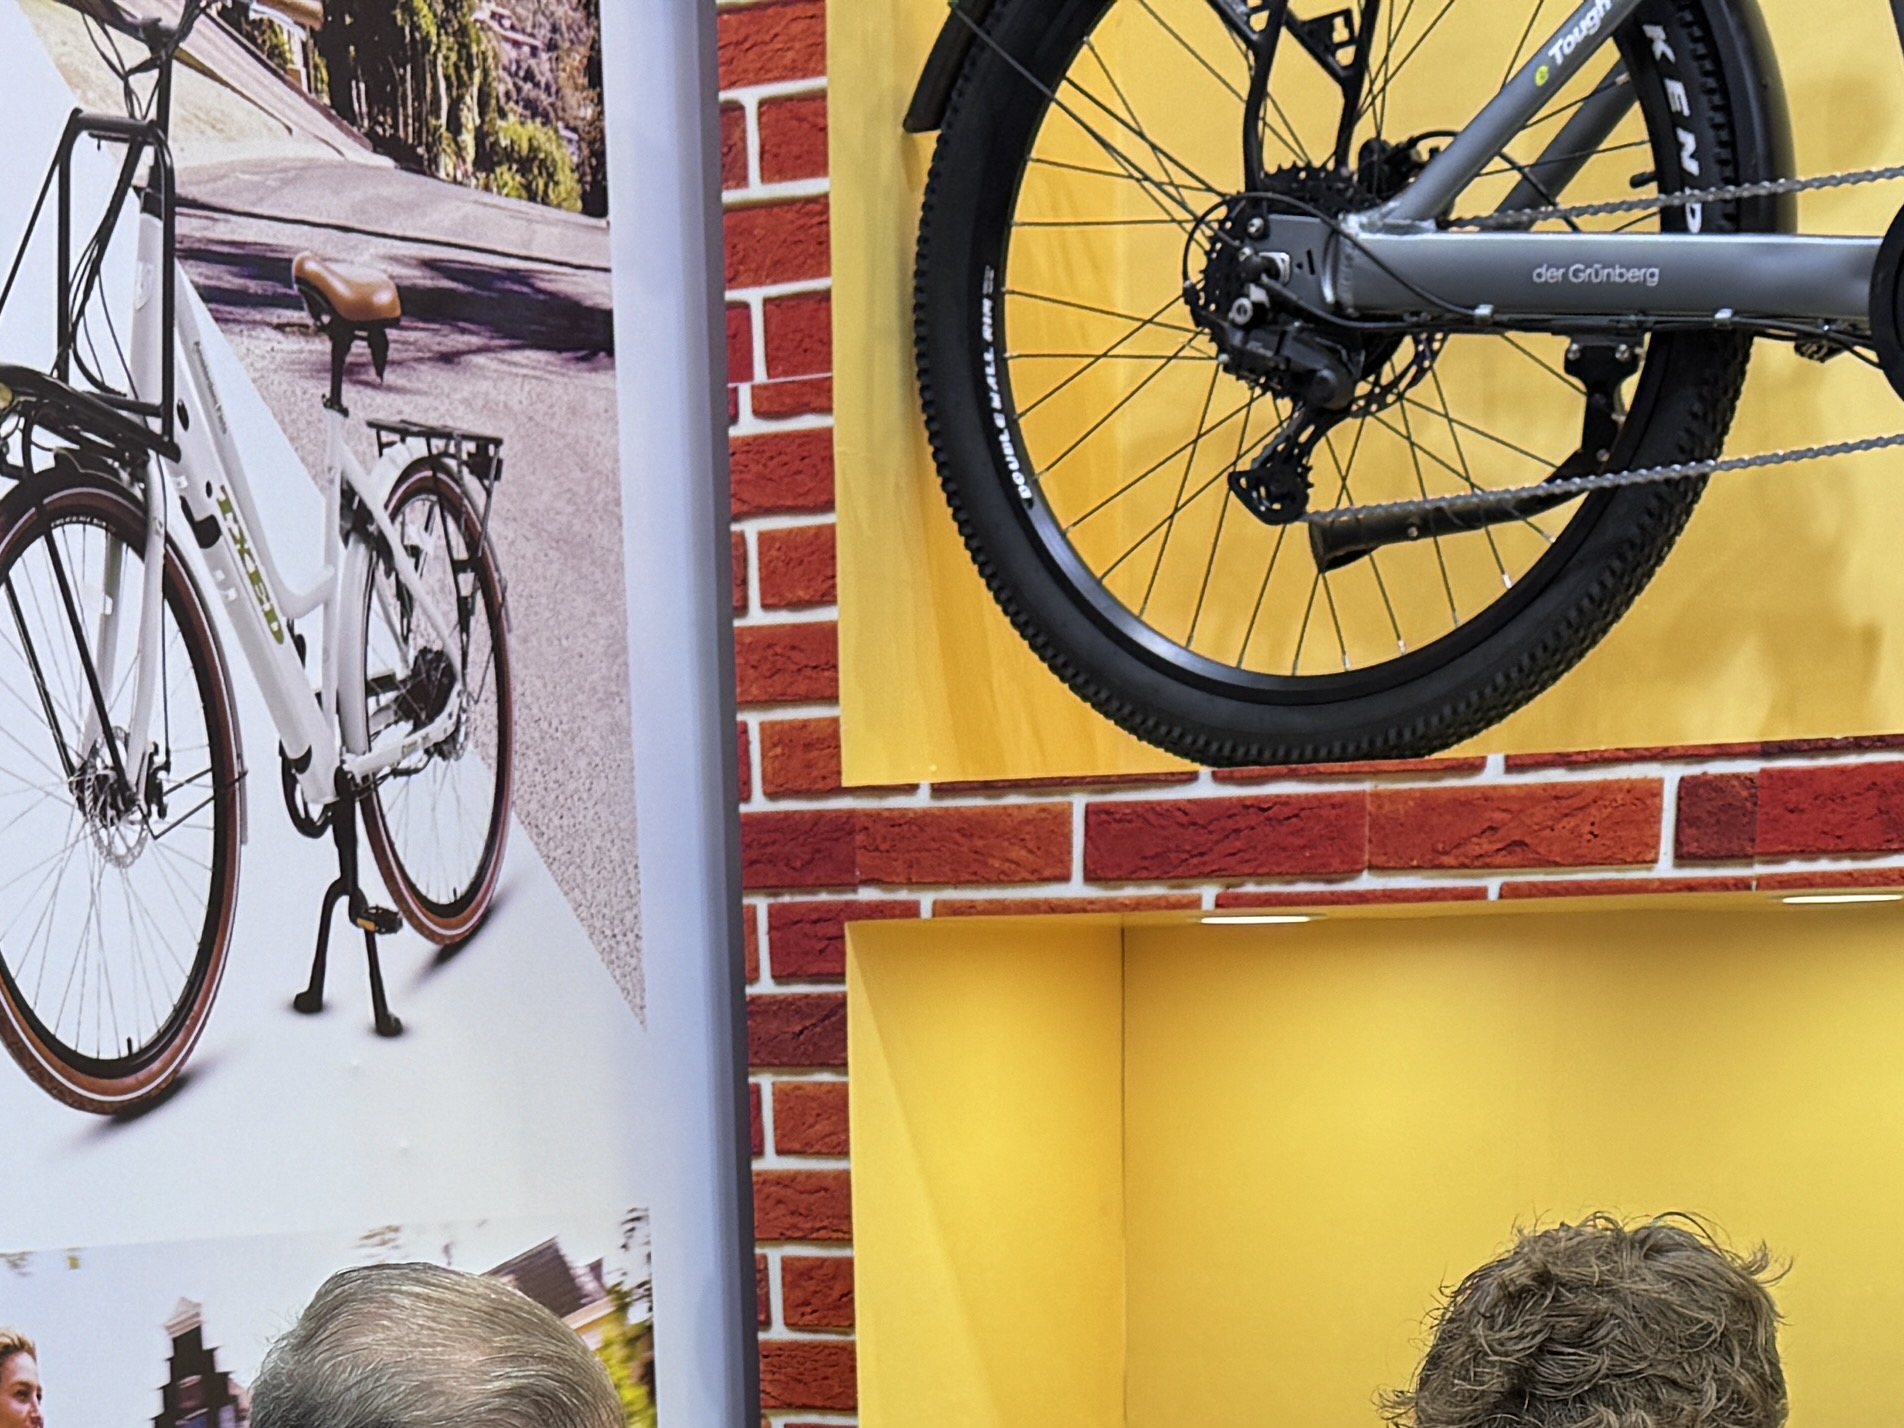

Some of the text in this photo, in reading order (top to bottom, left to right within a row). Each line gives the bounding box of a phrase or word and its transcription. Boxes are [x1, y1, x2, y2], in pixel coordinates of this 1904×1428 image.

[1642, 25, 1703, 234] KEND
[1533, 264, 1563, 283] der
[982, 297, 1032, 498] DOUBLE WALL RIM
[218, 489, 287, 646] TXED
